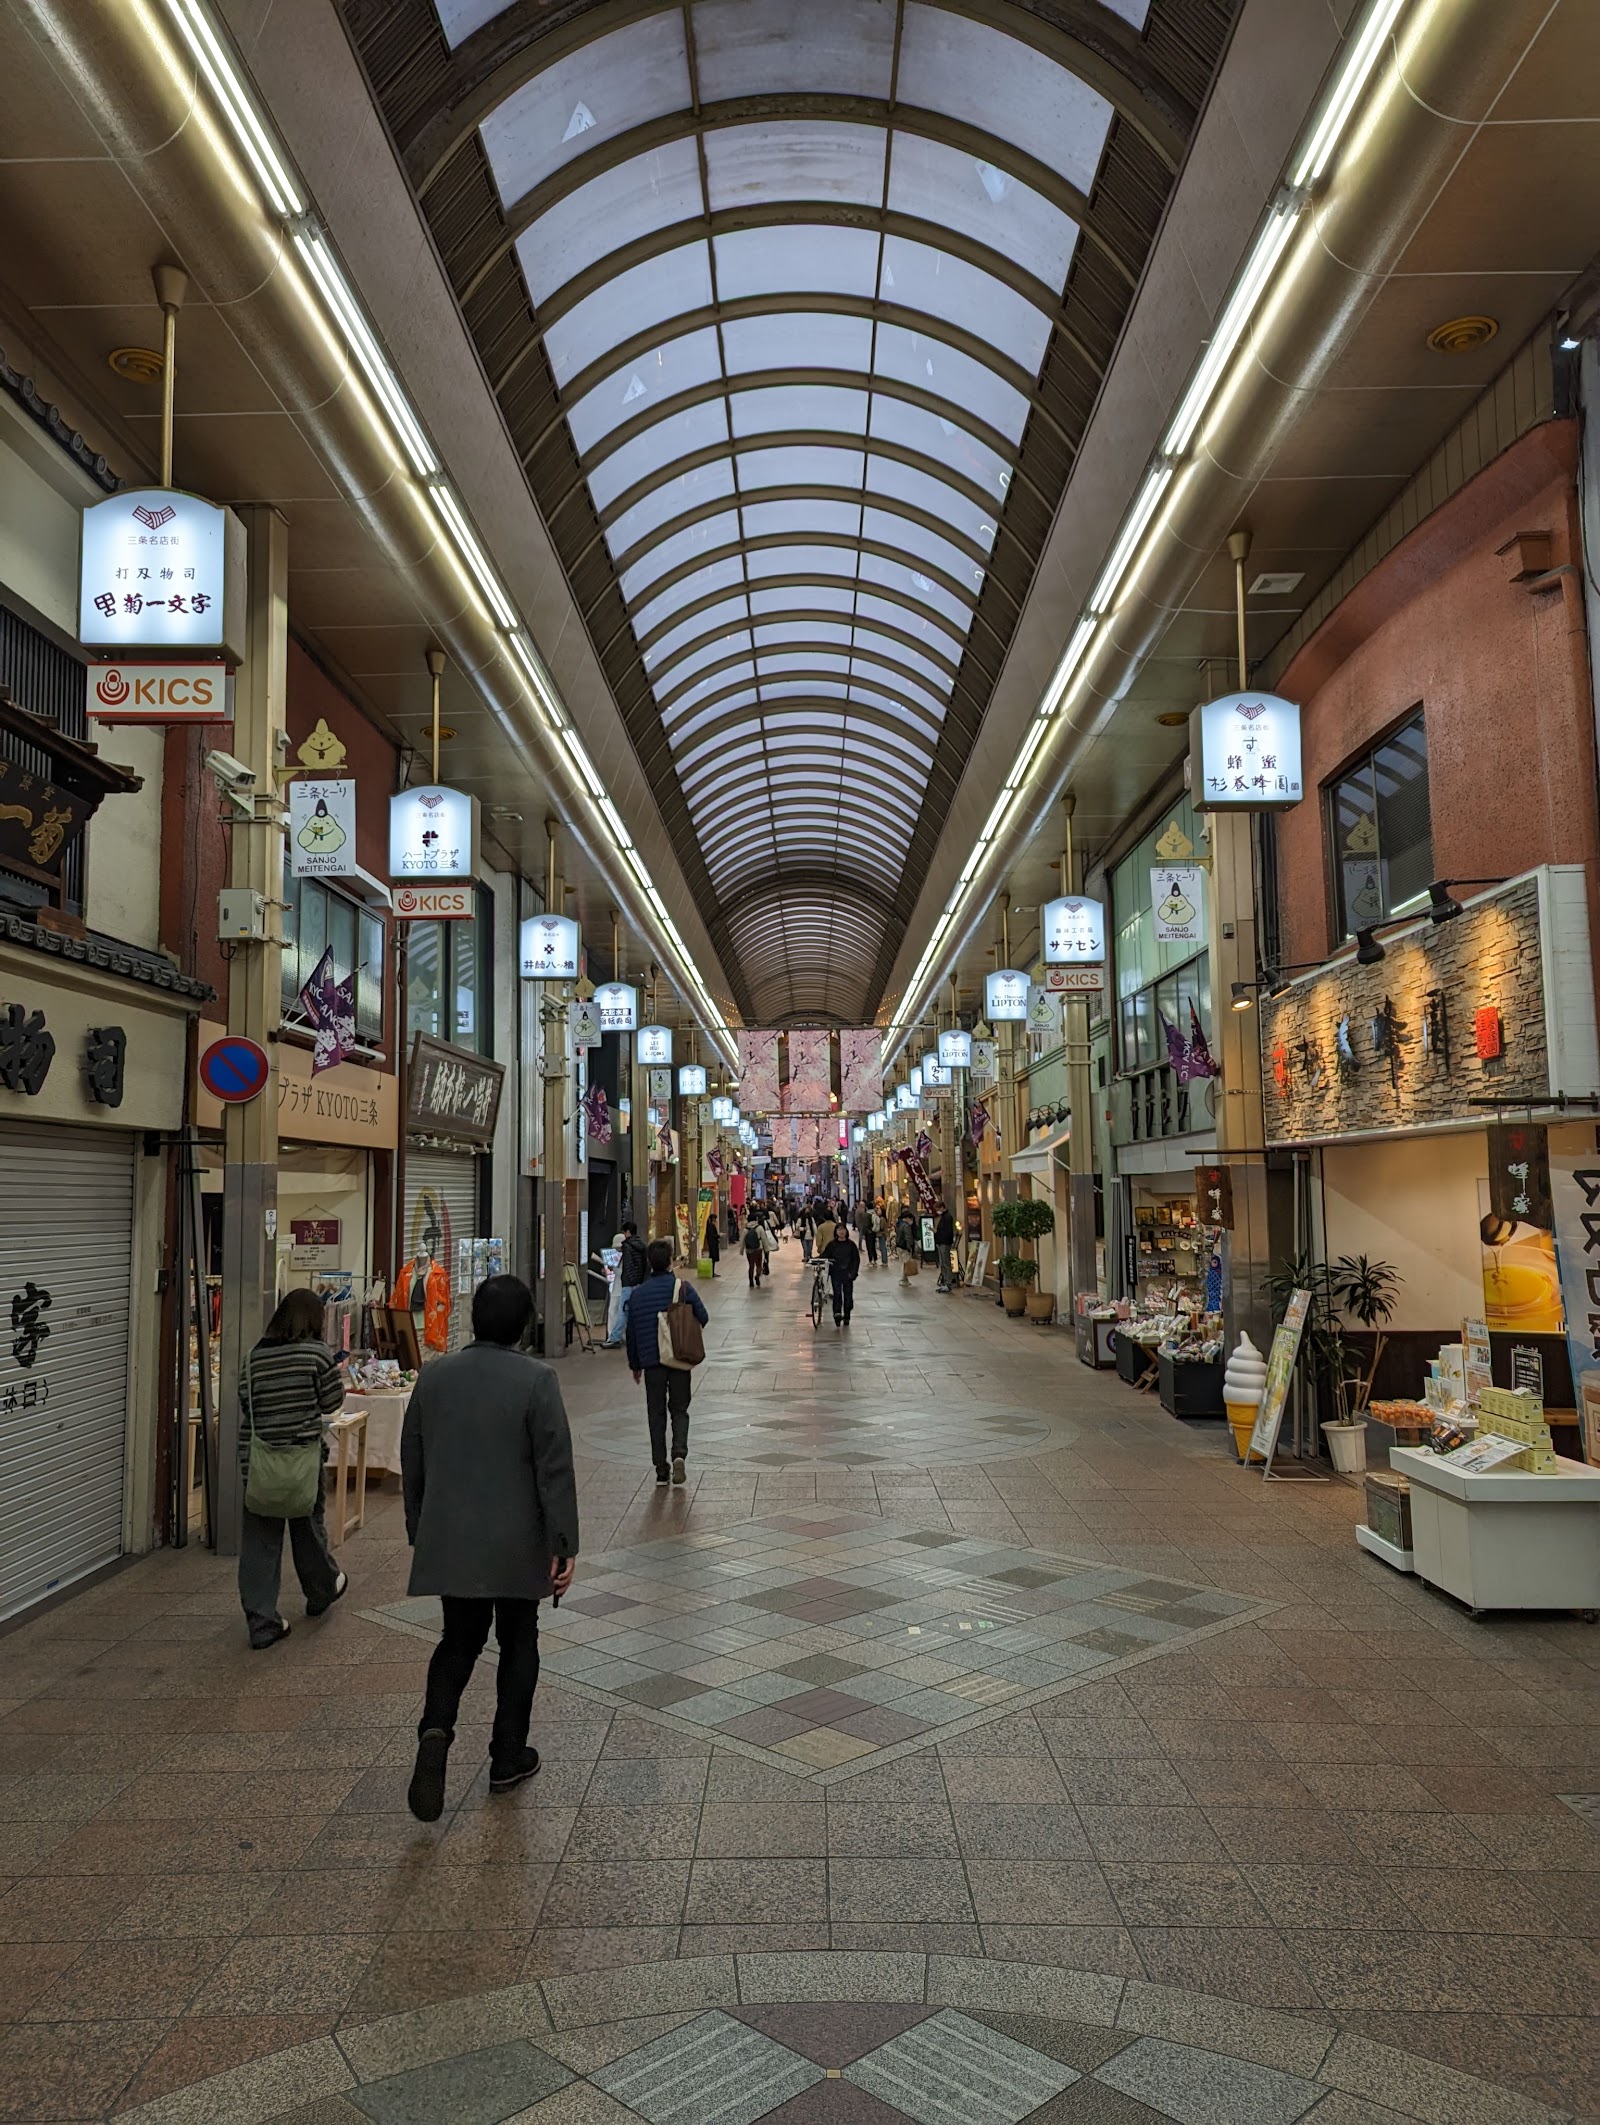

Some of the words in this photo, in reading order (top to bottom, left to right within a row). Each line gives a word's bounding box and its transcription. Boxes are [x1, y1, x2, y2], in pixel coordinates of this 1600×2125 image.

[127, 535, 180, 546] 三条名店街
[115, 567, 196, 581] 打刃物司
[123, 593, 212, 616] 菊一文字
[134, 678, 213, 706] KICS
[1227, 754, 1277, 770] 蜂蜜
[401, 849, 460, 860] ハートプラザ
[306, 857, 337, 865] SANJO
[402, 861, 438, 870] KYOTO
[440, 860, 460, 870] 三条
[297, 865, 347, 873] MEITENGAI
[419, 895, 465, 911] KICS
[1049, 939, 1101, 952] サラセン
[1066, 974, 1100, 986] KICS
